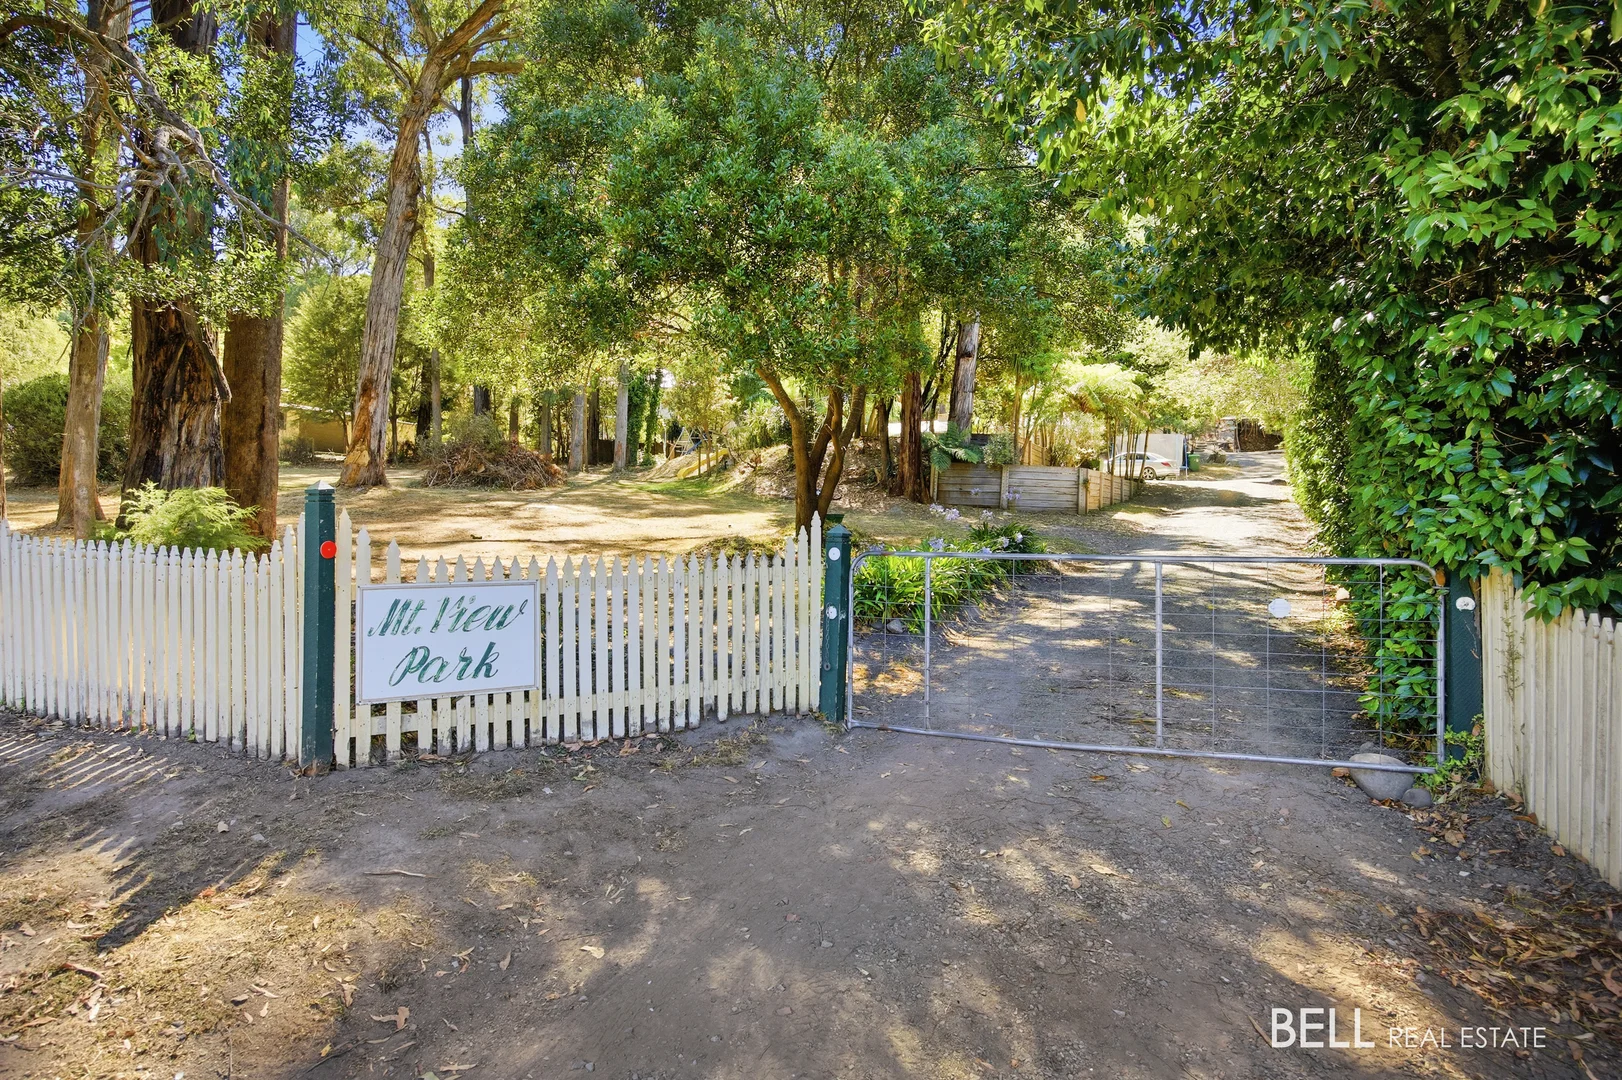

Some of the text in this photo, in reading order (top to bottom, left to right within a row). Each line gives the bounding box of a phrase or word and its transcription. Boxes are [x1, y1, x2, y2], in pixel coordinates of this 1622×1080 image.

[367, 595, 529, 636] Mt. View
[388, 641, 500, 687] Park
